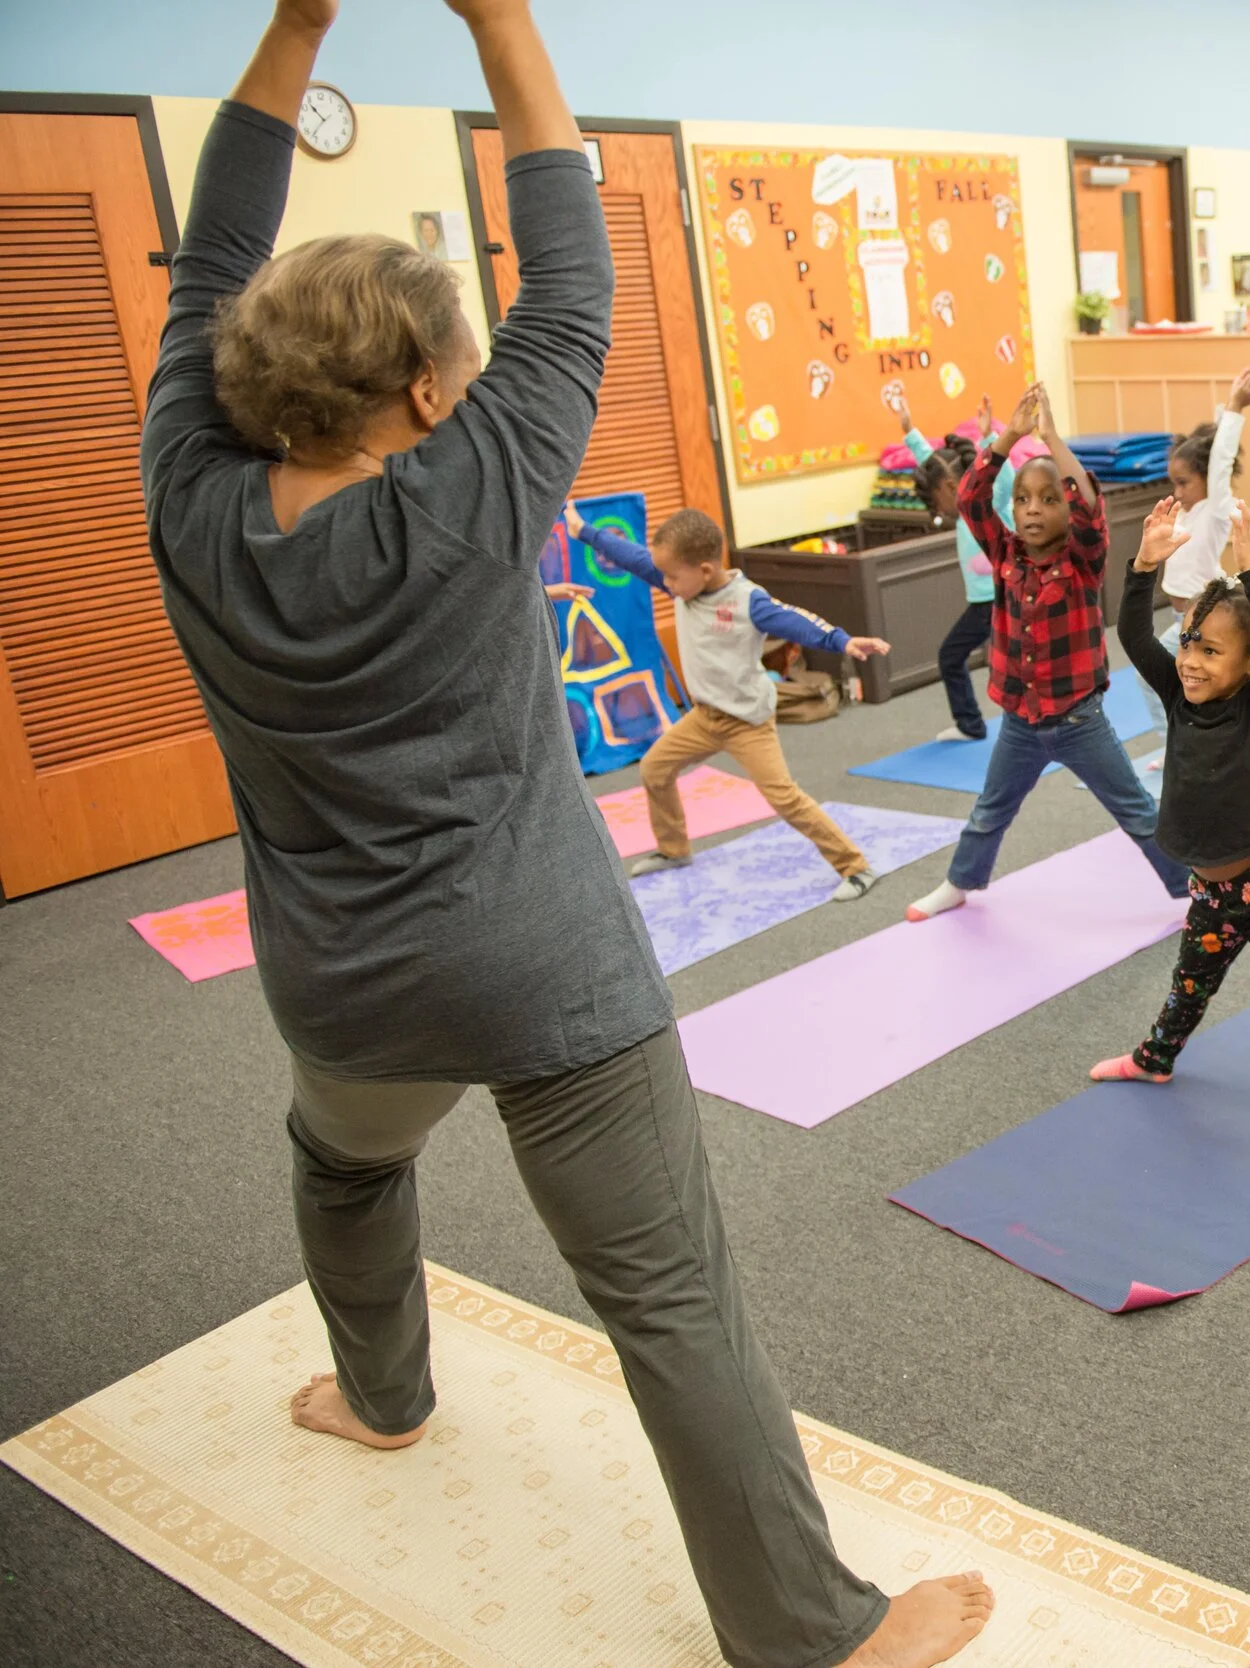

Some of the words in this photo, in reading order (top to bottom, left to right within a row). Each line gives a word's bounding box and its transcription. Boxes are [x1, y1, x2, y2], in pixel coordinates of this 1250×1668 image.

[317, 92, 325, 101] 12
[935, 179, 992, 203] FALL
[729, 177, 849, 364] STEPPING
[879, 350, 931, 374] INTO
